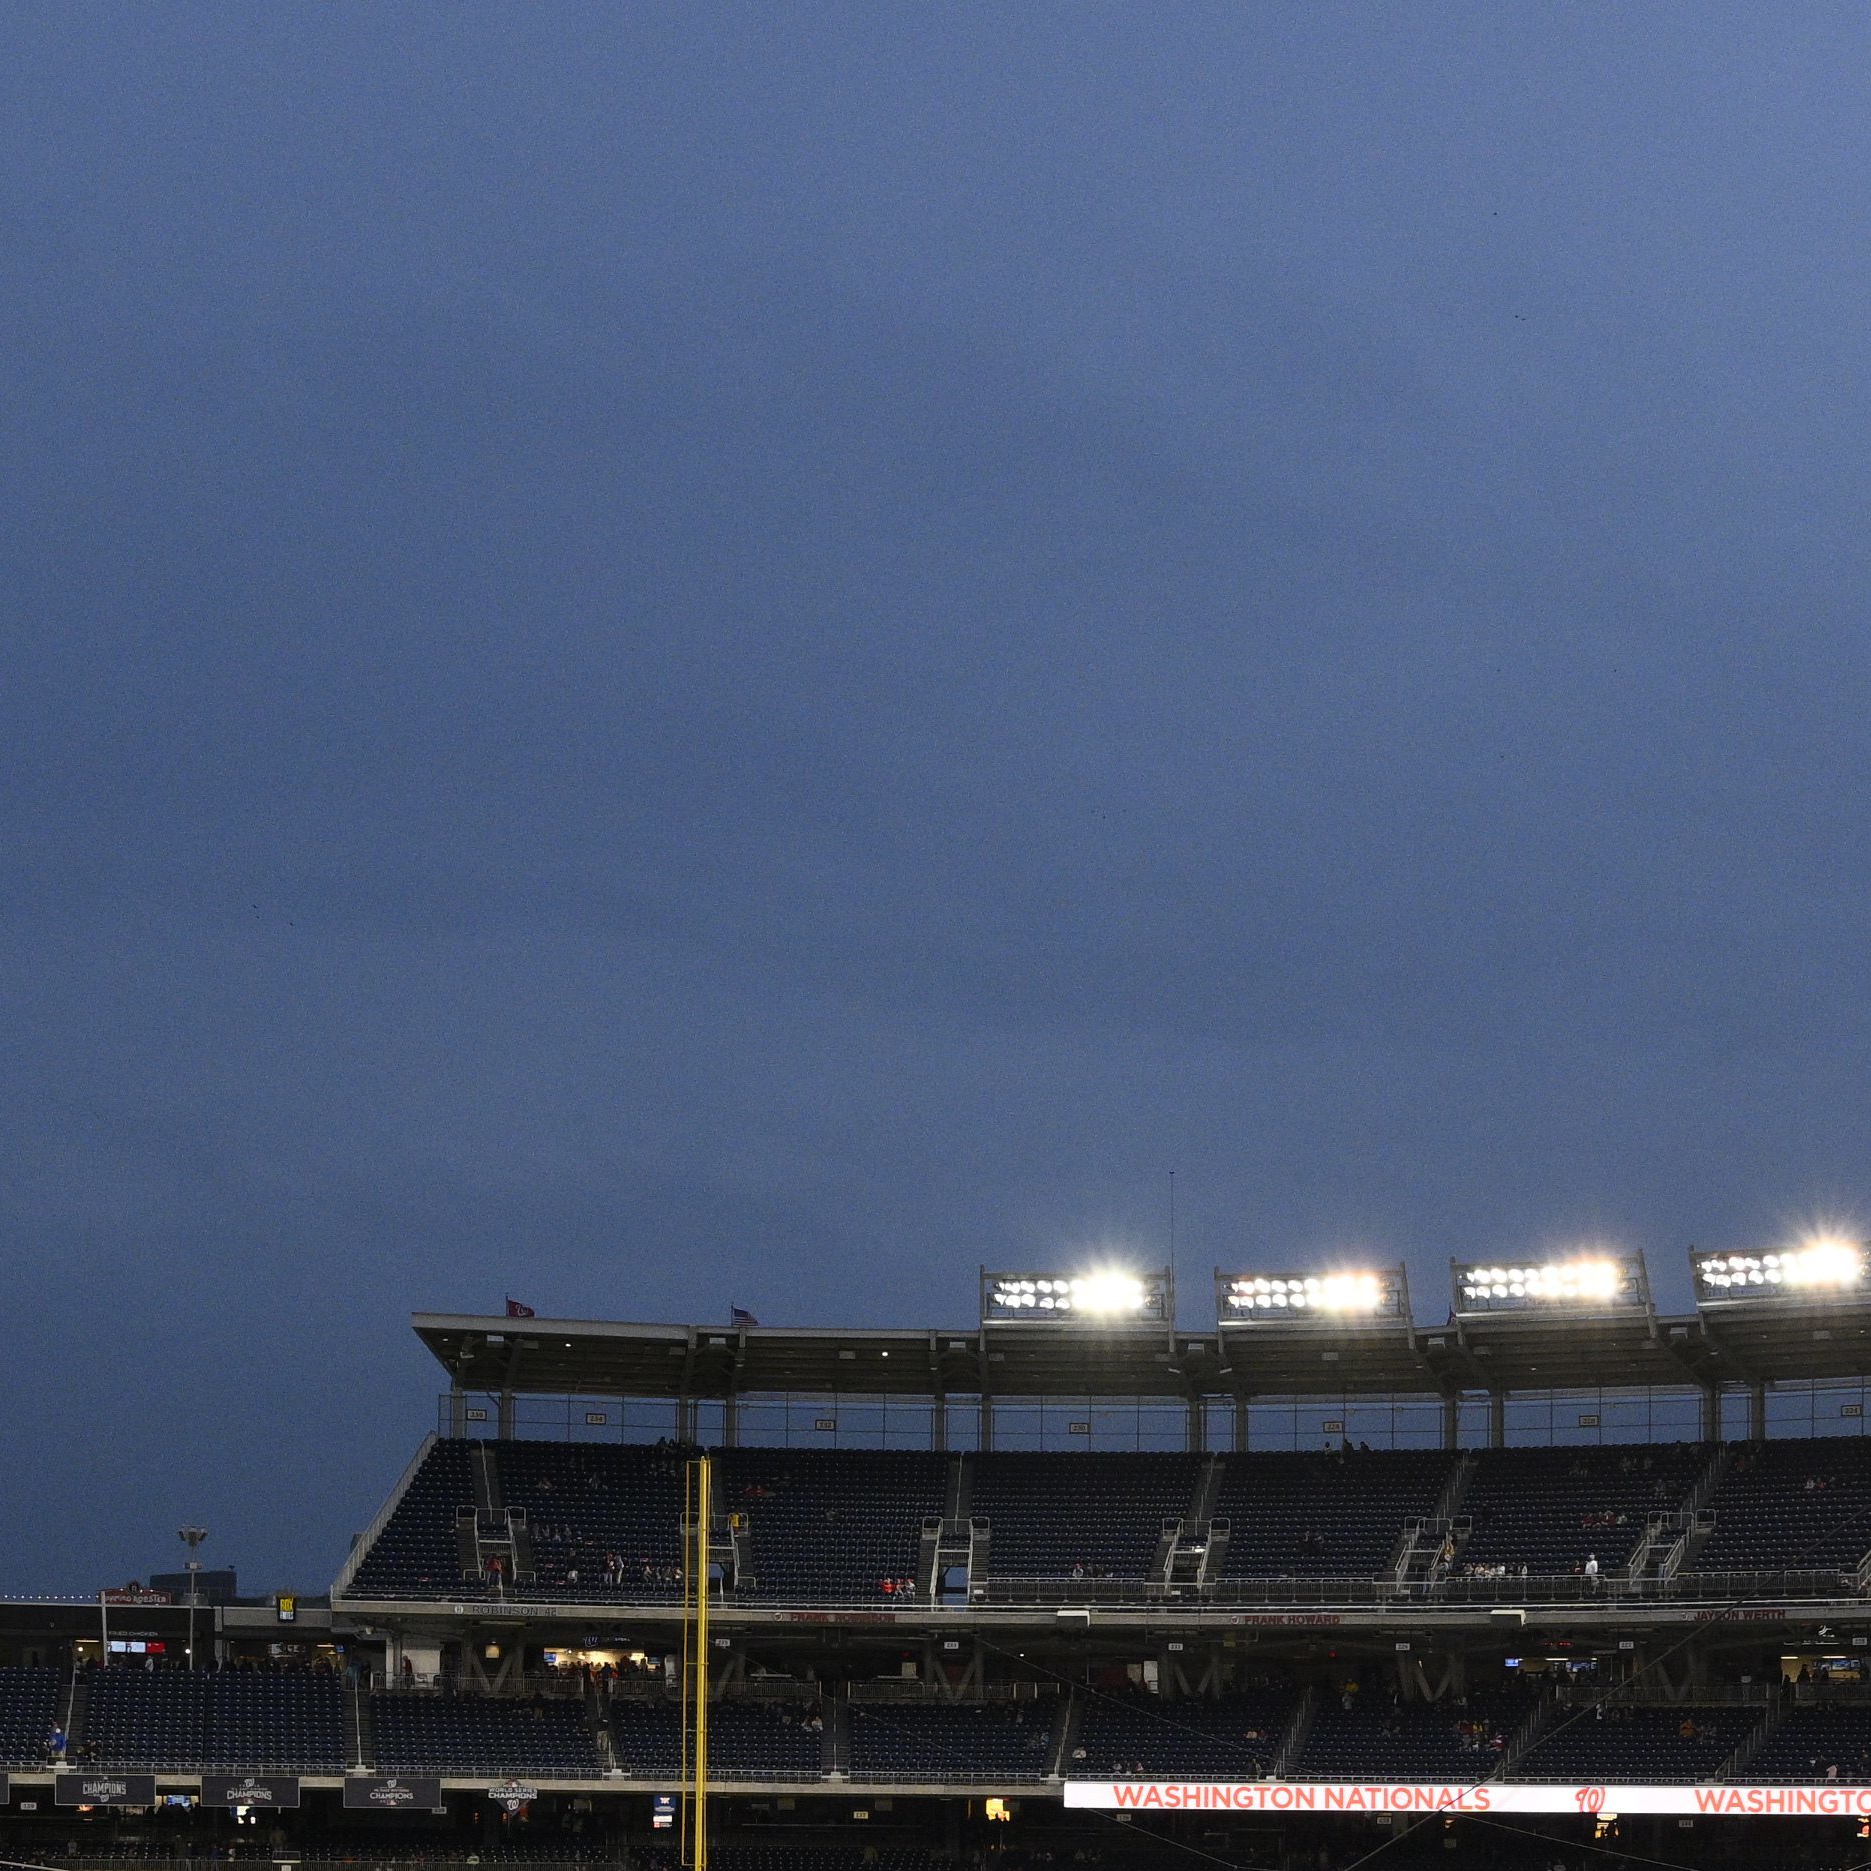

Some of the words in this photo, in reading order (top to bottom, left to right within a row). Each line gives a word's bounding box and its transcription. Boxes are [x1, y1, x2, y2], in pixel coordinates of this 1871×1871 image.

[472, 1604, 540, 1617] ROBINSON
[1694, 1609, 1740, 1621] JAYSON
[1743, 1609, 1786, 1620] WERTH
[1244, 1615, 1284, 1625] FRANK
[1289, 1615, 1341, 1626] HOWARD
[226, 1789, 273, 1801] CHAMPIONS
[369, 1791, 414, 1800] CHAMPIONS
[488, 1792, 538, 1800] CHAMPIONS
[1113, 1784, 1315, 1810] WASHINGTON
[1324, 1785, 1490, 1811] NATIONALS
